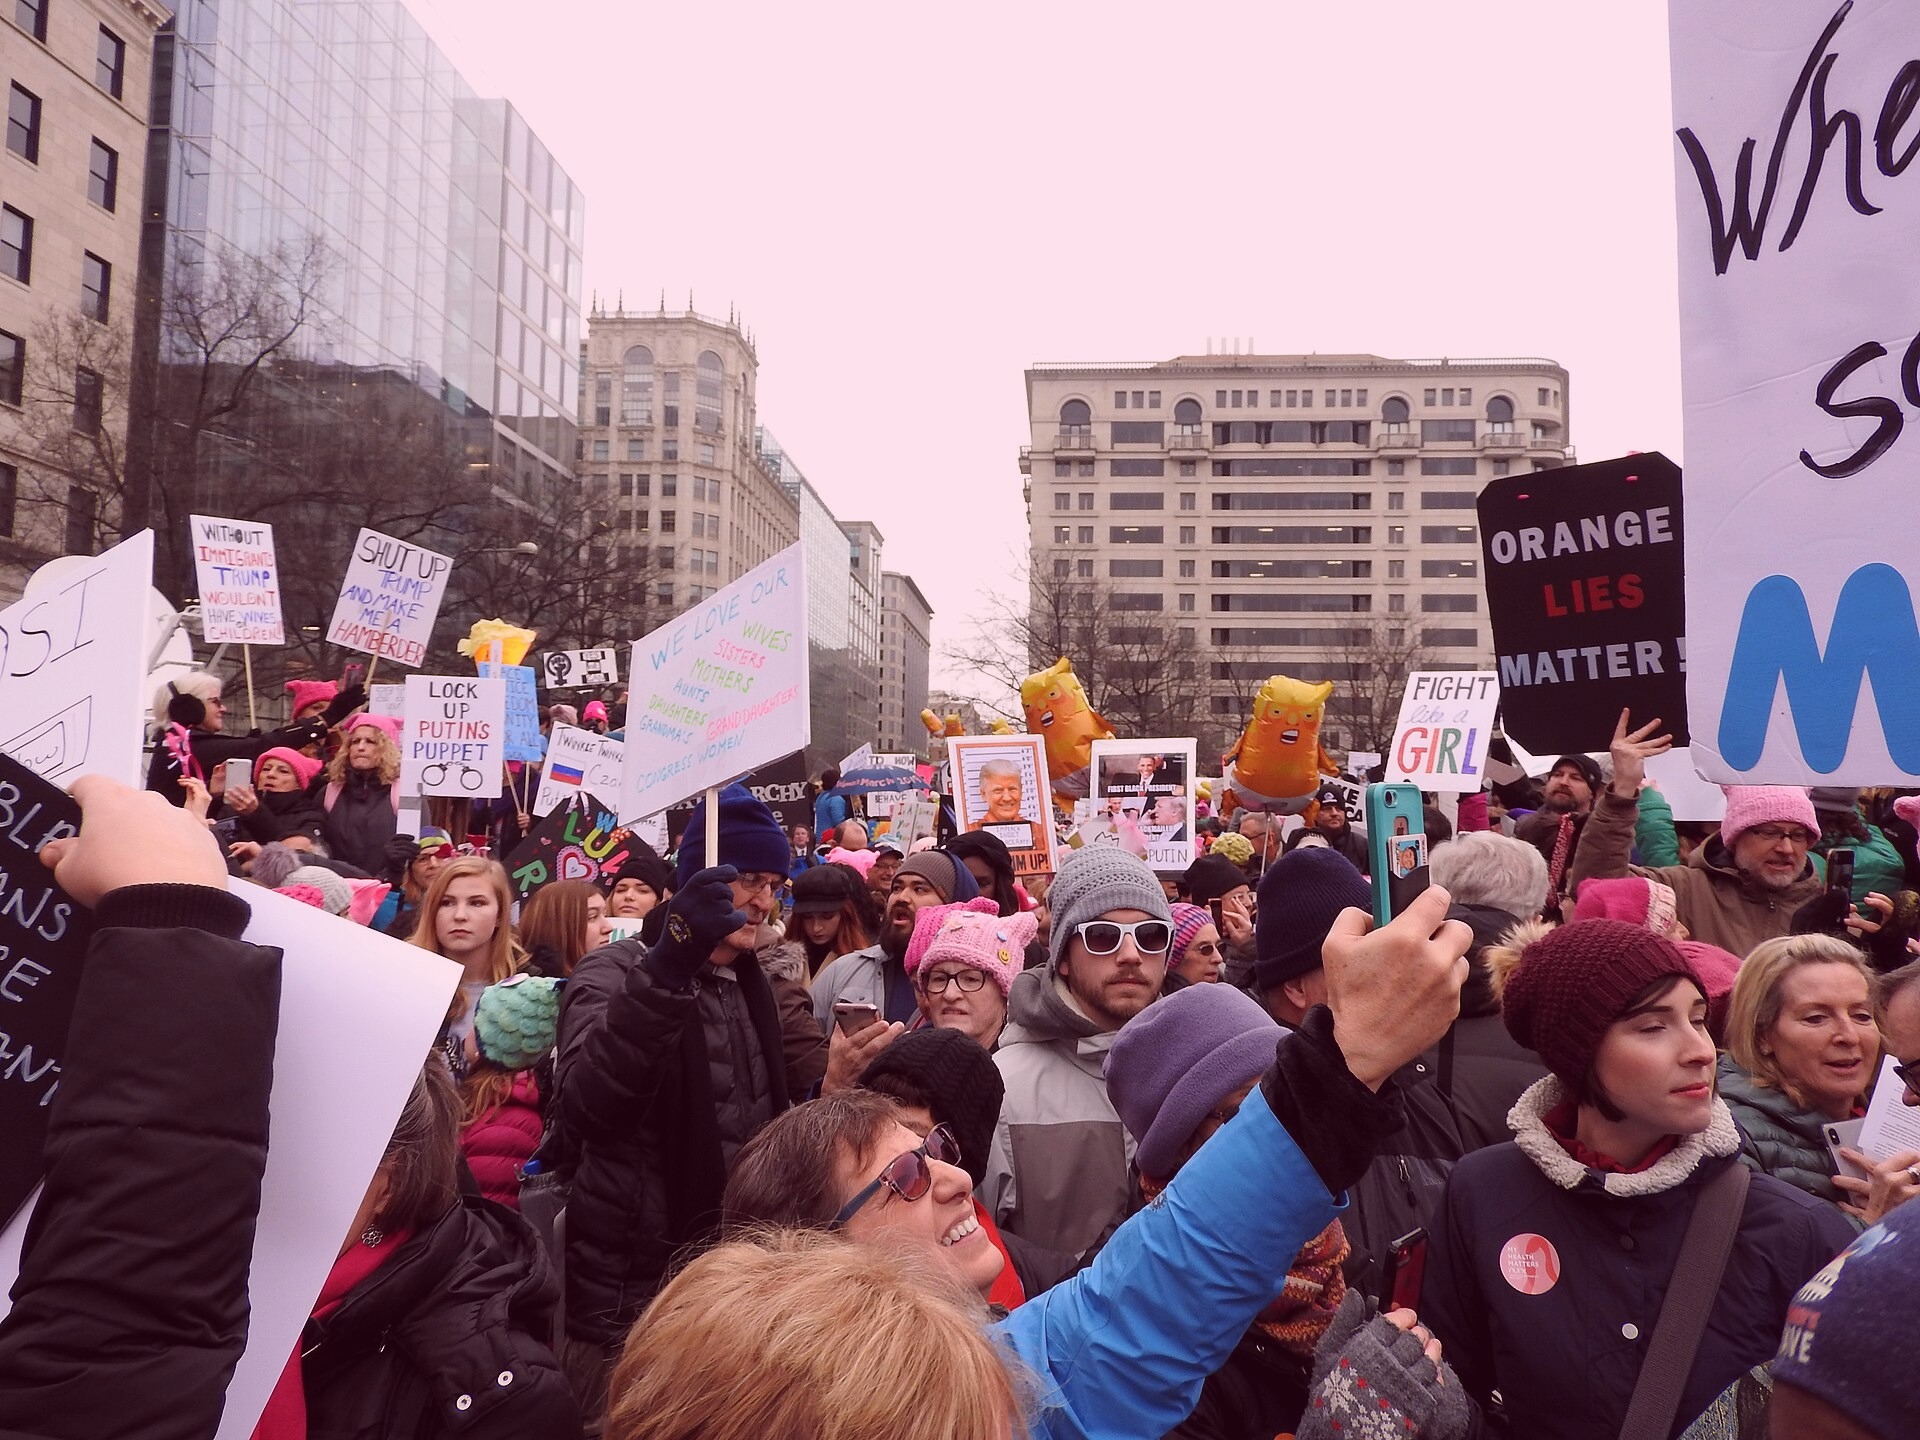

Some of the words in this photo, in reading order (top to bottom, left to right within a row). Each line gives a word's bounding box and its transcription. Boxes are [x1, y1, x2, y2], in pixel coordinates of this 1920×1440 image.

[201, 523, 264, 546] WITHOUT
[1491, 506, 1674, 564] ORANGE
[358, 535, 417, 572] SHUT
[418, 553, 447, 581] UP
[212, 566, 270, 588] TRUMP
[378, 569, 432, 601] TRUMP
[340, 585, 373, 604] AND
[372, 593, 424, 620] MAKE
[1543, 573, 1645, 617] LIES
[208, 608, 236, 624] HAVE
[240, 611, 276, 625] WIVES
[359, 608, 384, 626] ME
[386, 618, 400, 634] A
[651, 624, 686, 670] WE
[694, 594, 740, 640] LOVE
[751, 568, 788, 604] OUR
[333, 619, 426, 665] HAMBERDER
[743, 619, 792, 652] WIVES
[713, 638, 765, 668] SISTERS
[689, 657, 754, 693] MOTHERS
[1413, 676, 1495, 700] FIGHT
[429, 681, 478, 699] LOCK
[672, 678, 710, 702] AUNTS
[444, 703, 470, 719] UP
[648, 694, 708, 726] DAUGHTERS
[1404, 704, 1445, 723] like
[1452, 709, 1468, 723] a
[419, 720, 490, 740] PUTIN'S
[413, 742, 488, 761] PUPPET
[637, 754, 693, 793] CONGRESS
[699, 730, 745, 763] WOMEN
[1397, 727, 1478, 775] GIRL
[1030, 853, 1049, 870] UP!
[1148, 849, 1187, 862] PUTIN
